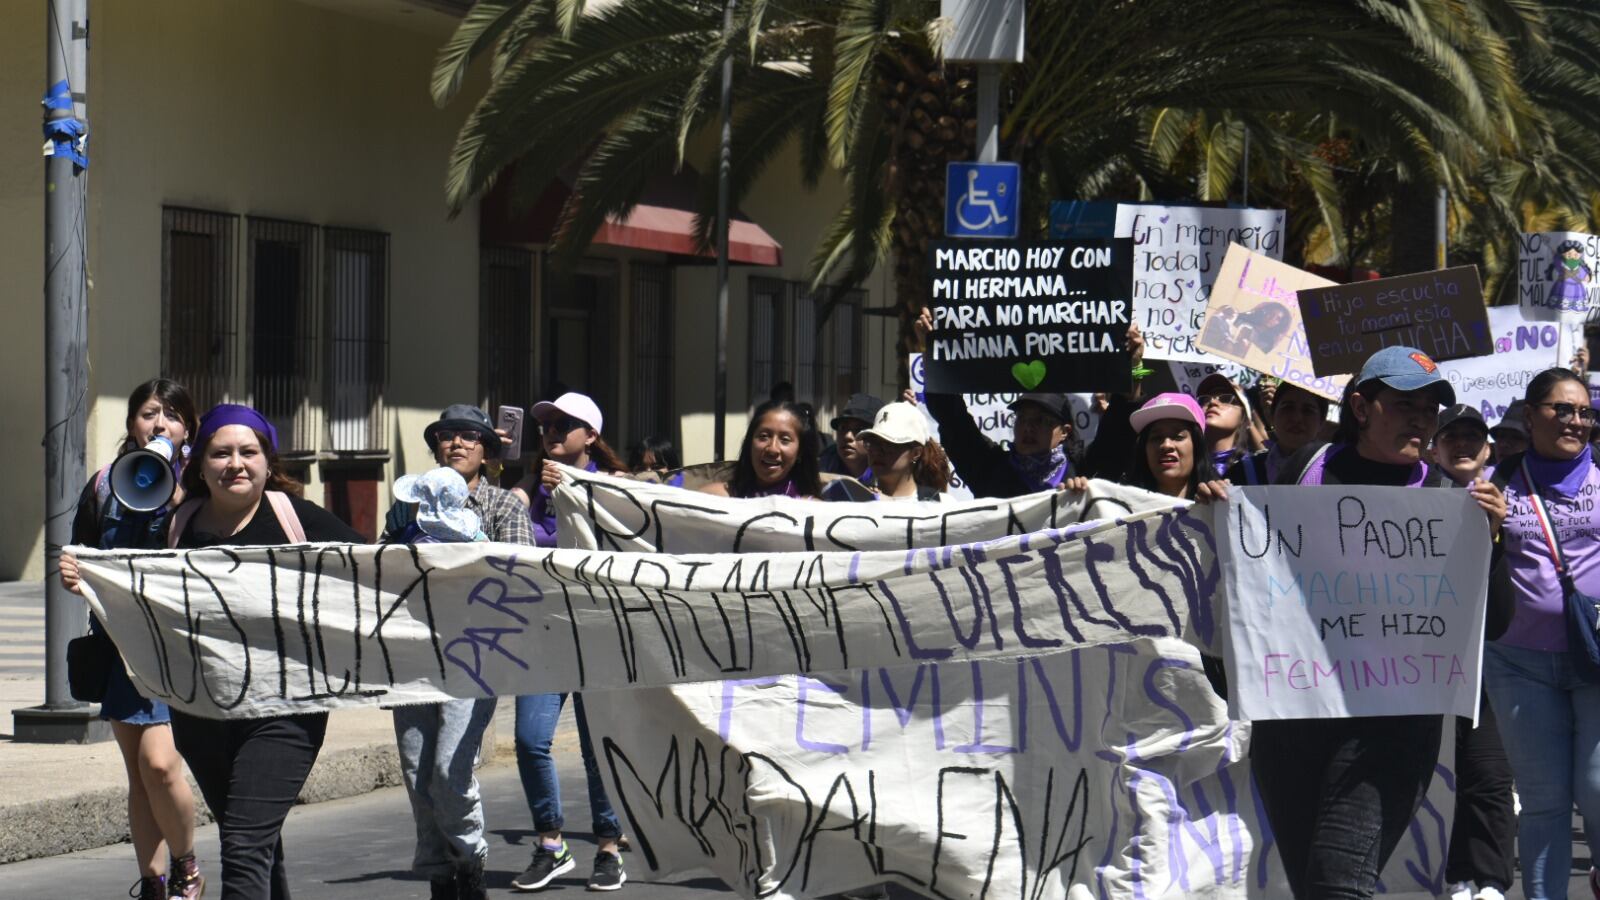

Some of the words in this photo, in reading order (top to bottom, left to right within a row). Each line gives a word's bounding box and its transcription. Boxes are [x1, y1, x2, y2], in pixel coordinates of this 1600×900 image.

[1132, 214, 1163, 247] En
[936, 248, 1020, 271] MARCHO
[1026, 247, 1064, 269] HOY
[1070, 247, 1111, 268] CON
[1520, 258, 1544, 282] FUE
[933, 279, 958, 299] MI
[1376, 276, 1459, 306] escucha
[934, 305, 986, 330] PARA
[996, 305, 1022, 327] NO
[1028, 301, 1128, 326] MARCHAR
[1336, 317, 1356, 335] tu
[933, 331, 1018, 361] MAÑANA
[1516, 325, 1558, 351] NO
[1567, 499, 1594, 514] SAID
[1569, 515, 1592, 527] FUCK
[1268, 571, 1459, 607] MACHISTA
[443, 553, 544, 697] PARA
[1320, 613, 1366, 640] ME
[1381, 613, 1446, 639] HIZO
[1264, 653, 1468, 698] FEMINISTA
